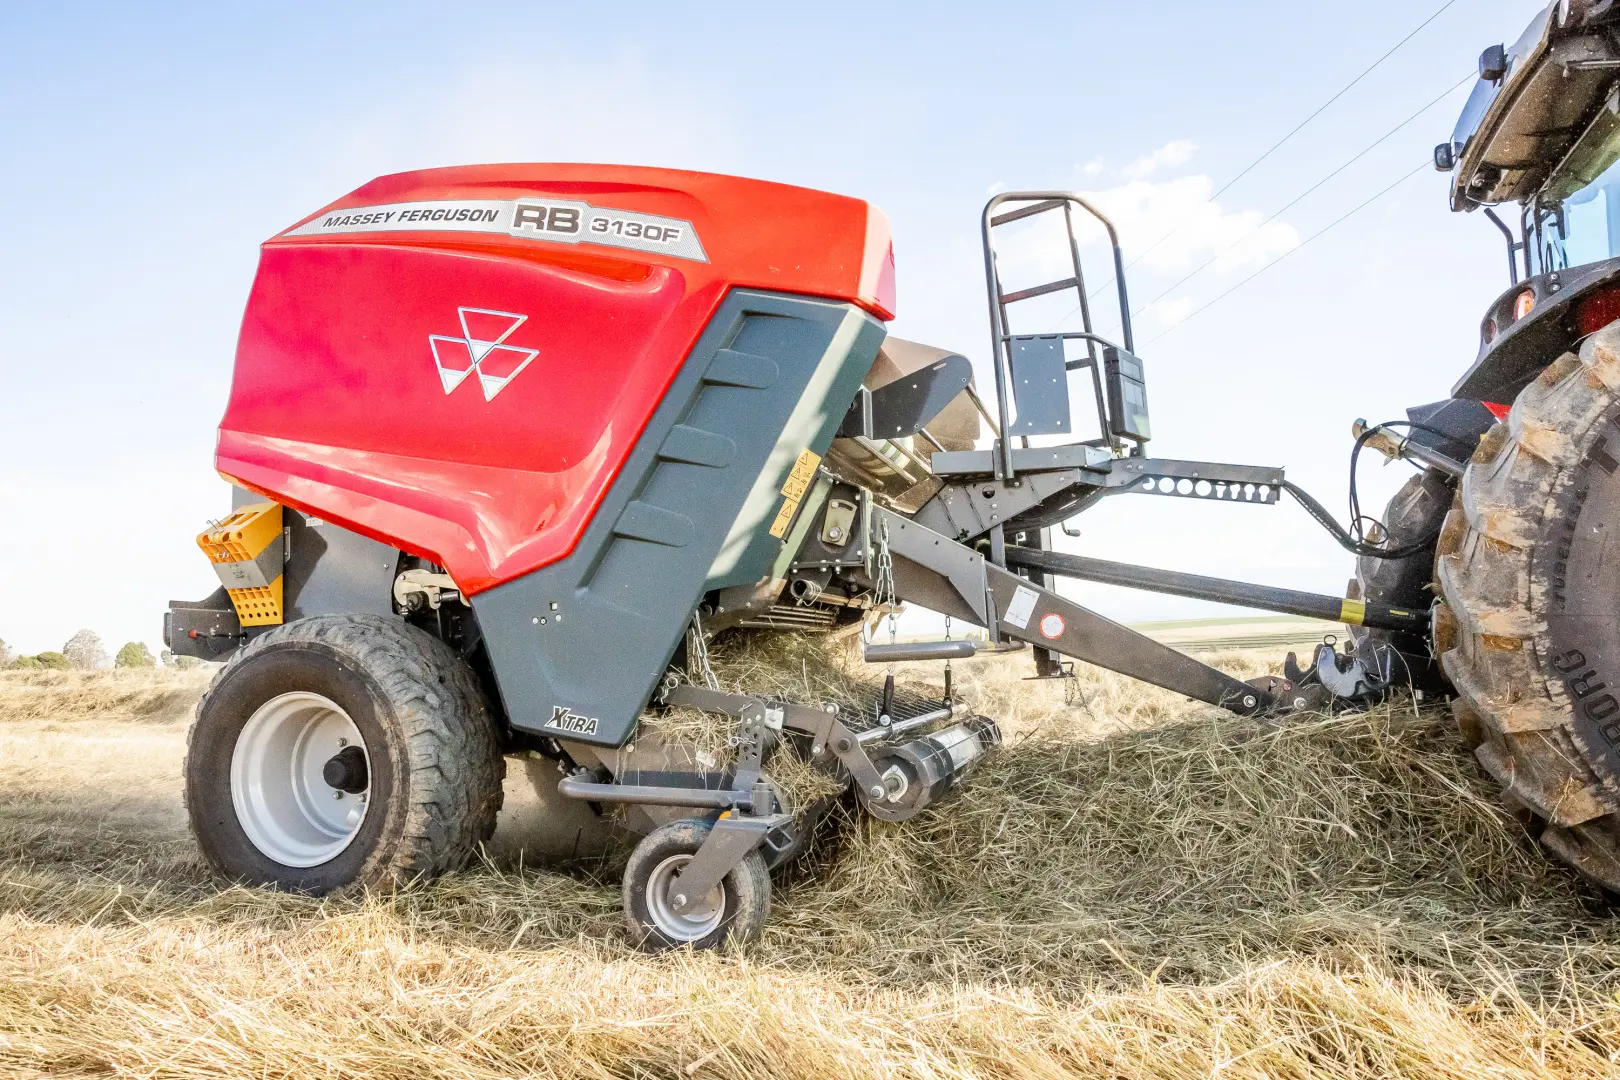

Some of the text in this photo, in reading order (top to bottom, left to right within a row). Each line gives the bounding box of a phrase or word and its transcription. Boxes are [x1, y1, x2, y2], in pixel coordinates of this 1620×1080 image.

[322, 204, 680, 242] MASSEY FERGUSON RB 3130F
[544, 705, 599, 736] XTRA
